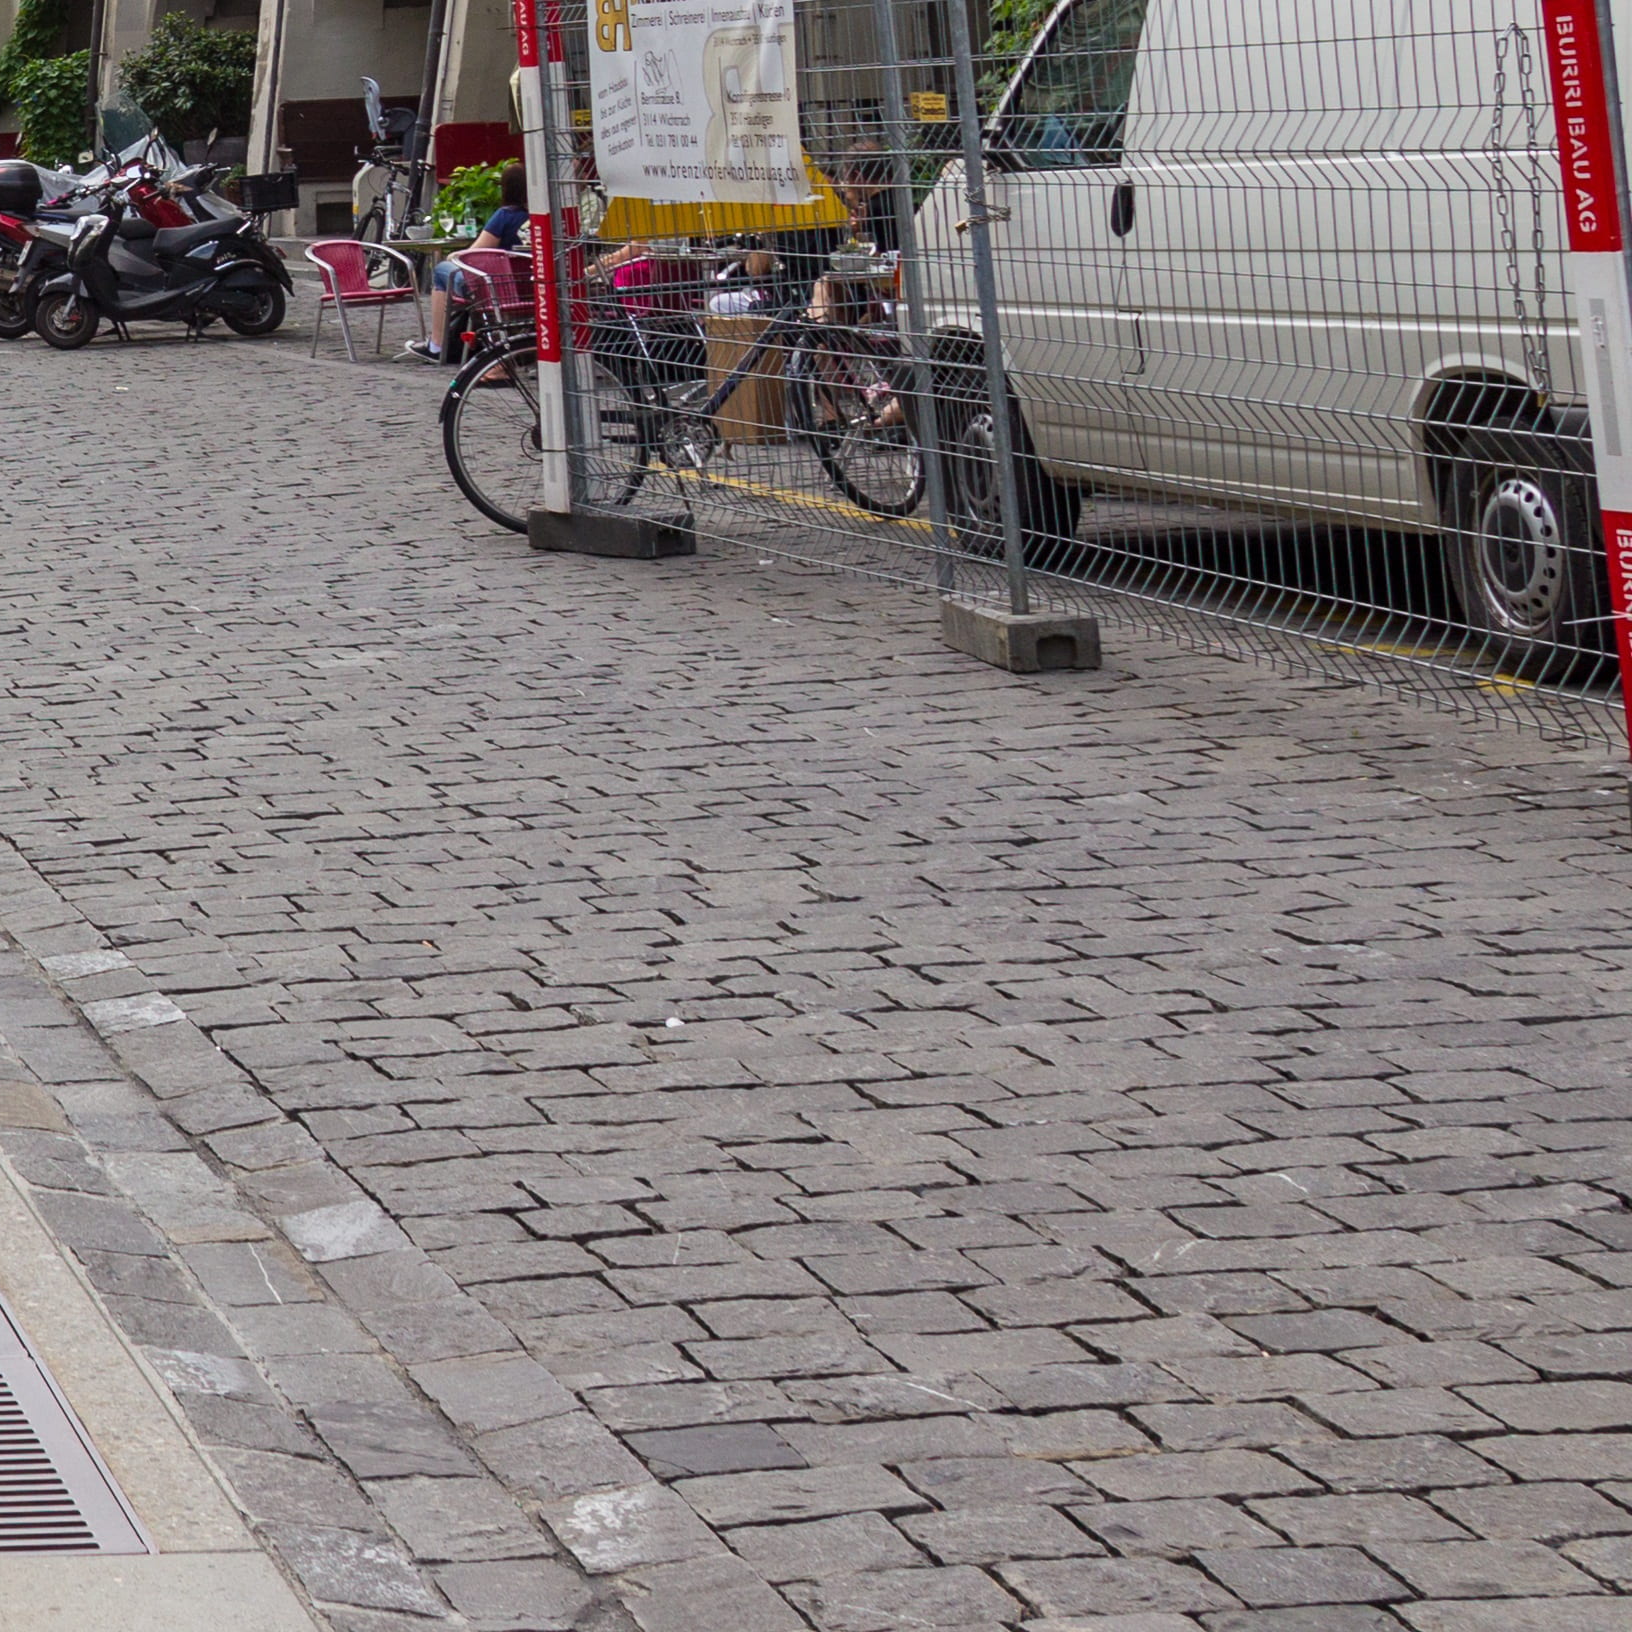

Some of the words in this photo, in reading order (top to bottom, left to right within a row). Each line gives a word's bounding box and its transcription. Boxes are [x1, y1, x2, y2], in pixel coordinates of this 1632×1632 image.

[521, 30, 530, 56] AG
[1555, 15, 1584, 108] BURRI
[1567, 117, 1591, 181] BAU
[1575, 188, 1598, 233] AG
[534, 225, 545, 280] BURRI
[537, 283, 548, 321] BAU
[540, 323, 551, 350] AG
